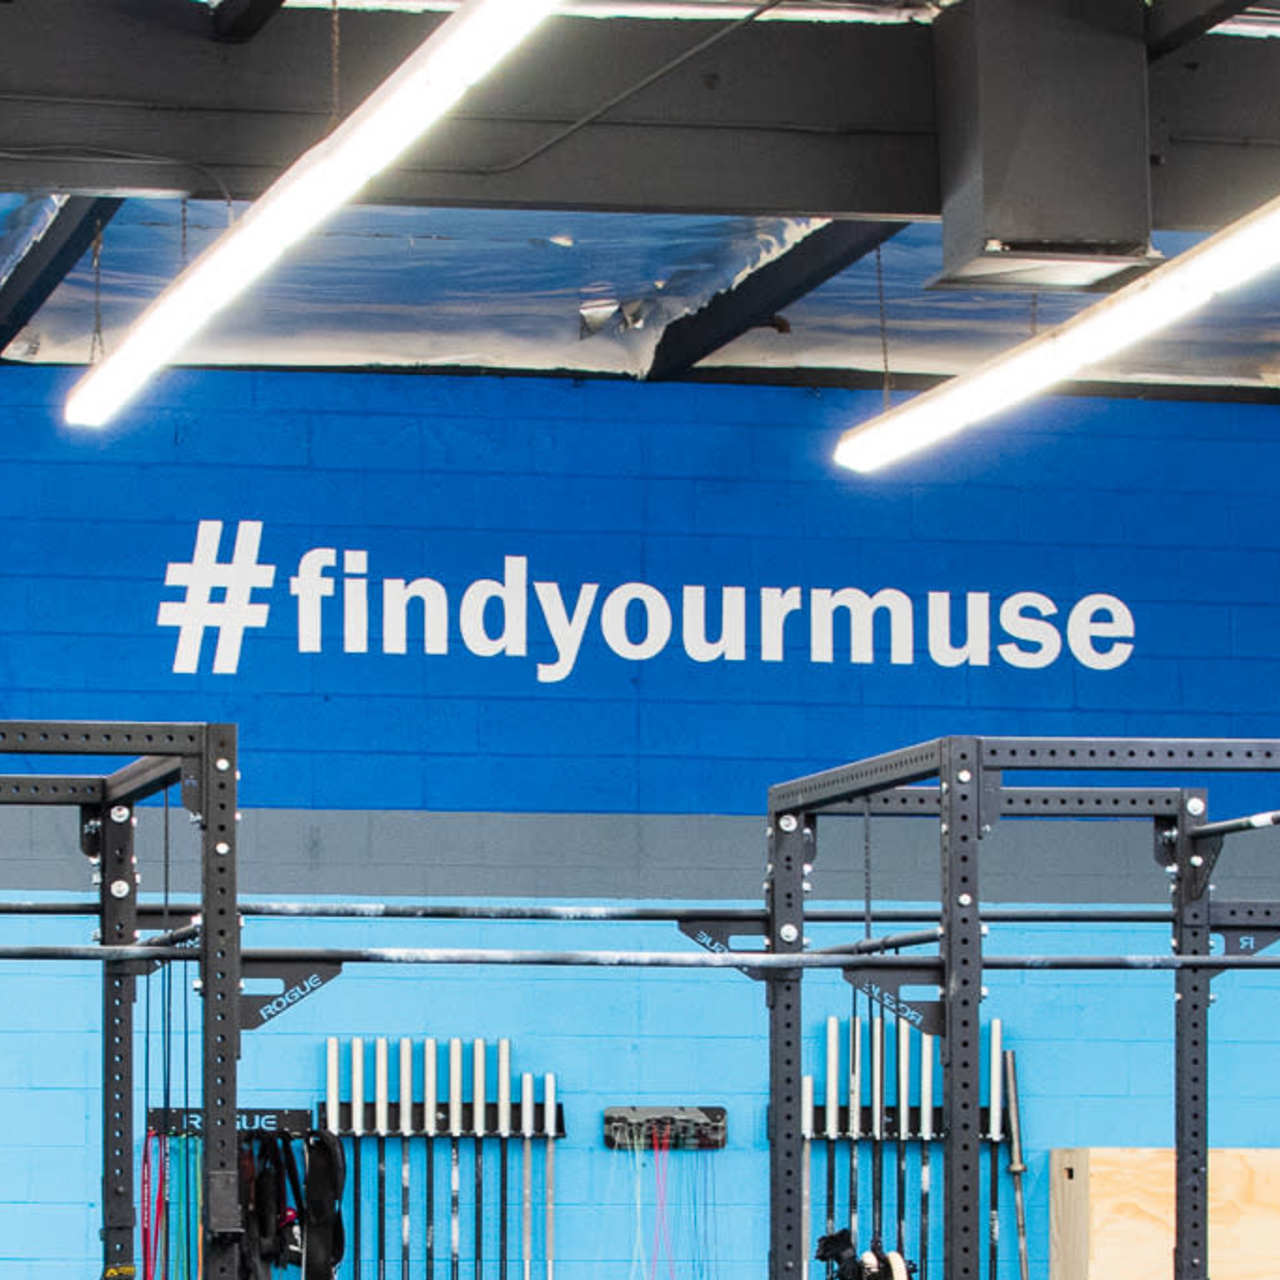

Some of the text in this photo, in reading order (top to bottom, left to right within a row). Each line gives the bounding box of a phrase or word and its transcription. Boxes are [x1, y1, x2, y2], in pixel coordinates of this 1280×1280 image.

[157, 518, 1136, 684] #findyourmuse
[260, 974, 322, 1021] ROGUE
[182, 1113, 278, 1131] RUE
